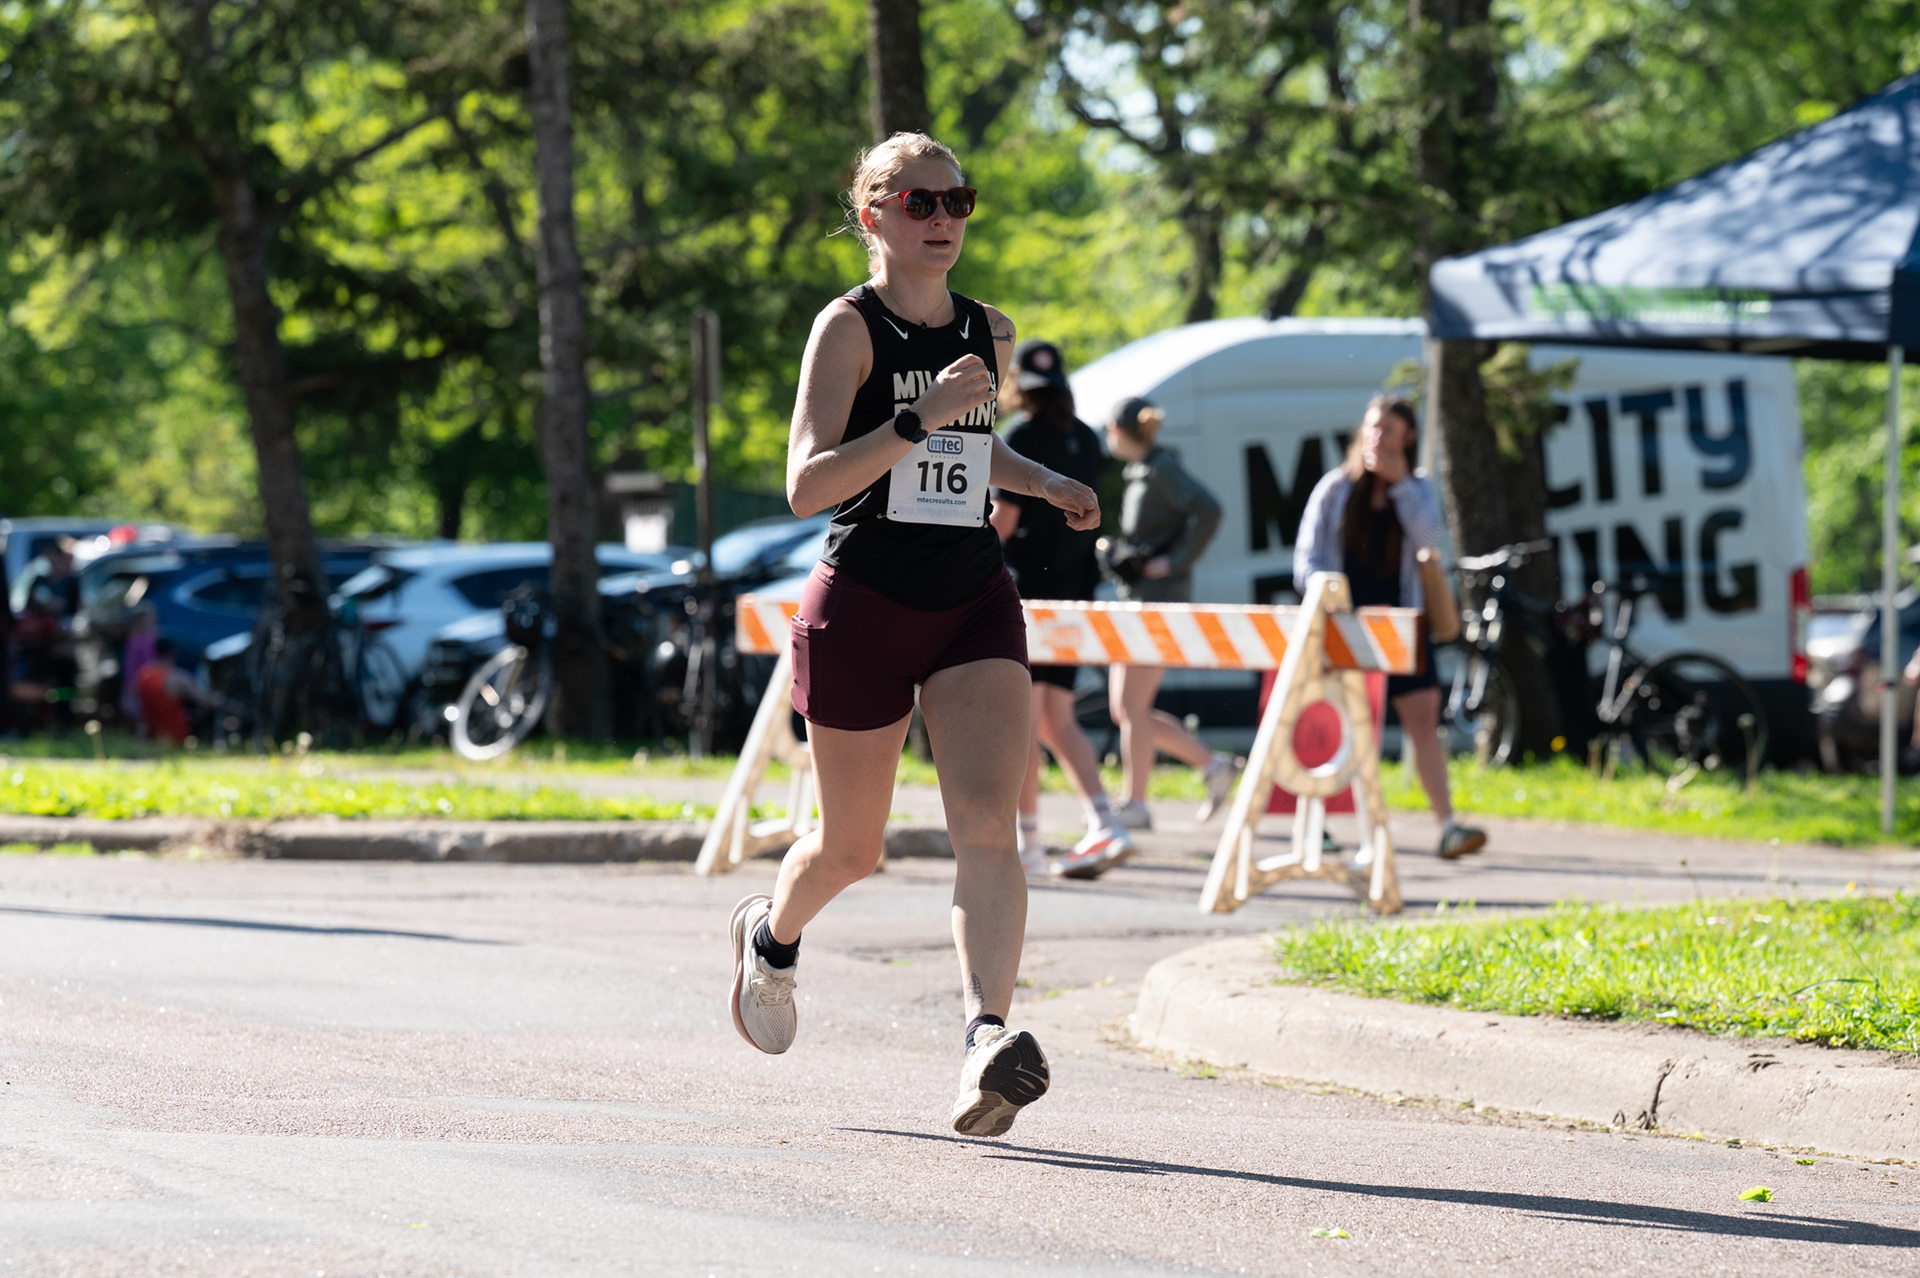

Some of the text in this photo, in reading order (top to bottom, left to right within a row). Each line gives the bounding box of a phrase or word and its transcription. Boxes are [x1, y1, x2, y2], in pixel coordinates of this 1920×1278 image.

[930, 438, 961, 452] mtec
[917, 460, 968, 495] 116
[916, 496, 967, 506] mtecresults.com
